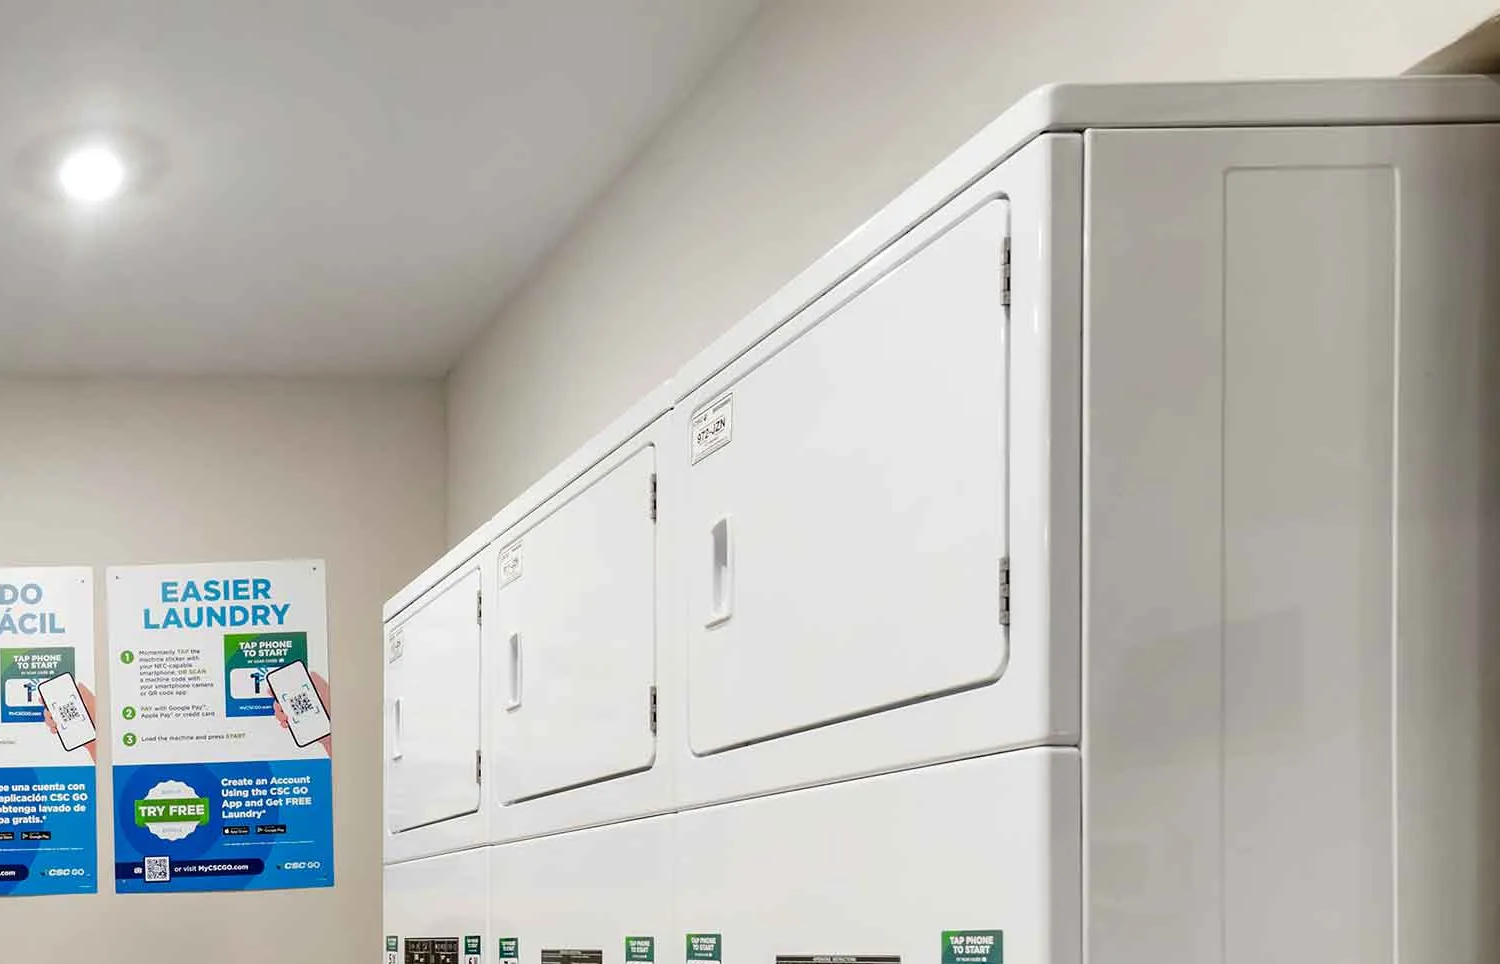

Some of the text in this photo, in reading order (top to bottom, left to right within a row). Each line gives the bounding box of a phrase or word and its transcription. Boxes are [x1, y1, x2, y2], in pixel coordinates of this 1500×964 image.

[161, 578, 271, 604] EASIER
[143, 603, 291, 629] LAUNDRY
[259, 640, 292, 649] PHONE
[258, 649, 289, 657] START
[31, 654, 62, 662] PHONE
[30, 661, 59, 669] START
[221, 777, 253, 786] Create
[270, 775, 311, 785] Account
[11, 784, 30, 792] una
[32, 782, 65, 791] cuenta
[67, 783, 85, 791] con
[221, 786, 308, 798] Using the CSC GO
[49, 793, 70, 801] CSC
[72, 793, 88, 801] GO
[221, 796, 312, 809] App and Get FREE
[38, 804, 71, 812] lavado
[73, 803, 86, 812] de
[138, 804, 205, 817] TRY FREE
[307, 861, 321, 869] GO
[71, 868, 85, 876] GO
[949, 935, 994, 945] TAP PHONE
[953, 945, 990, 954] TO START
